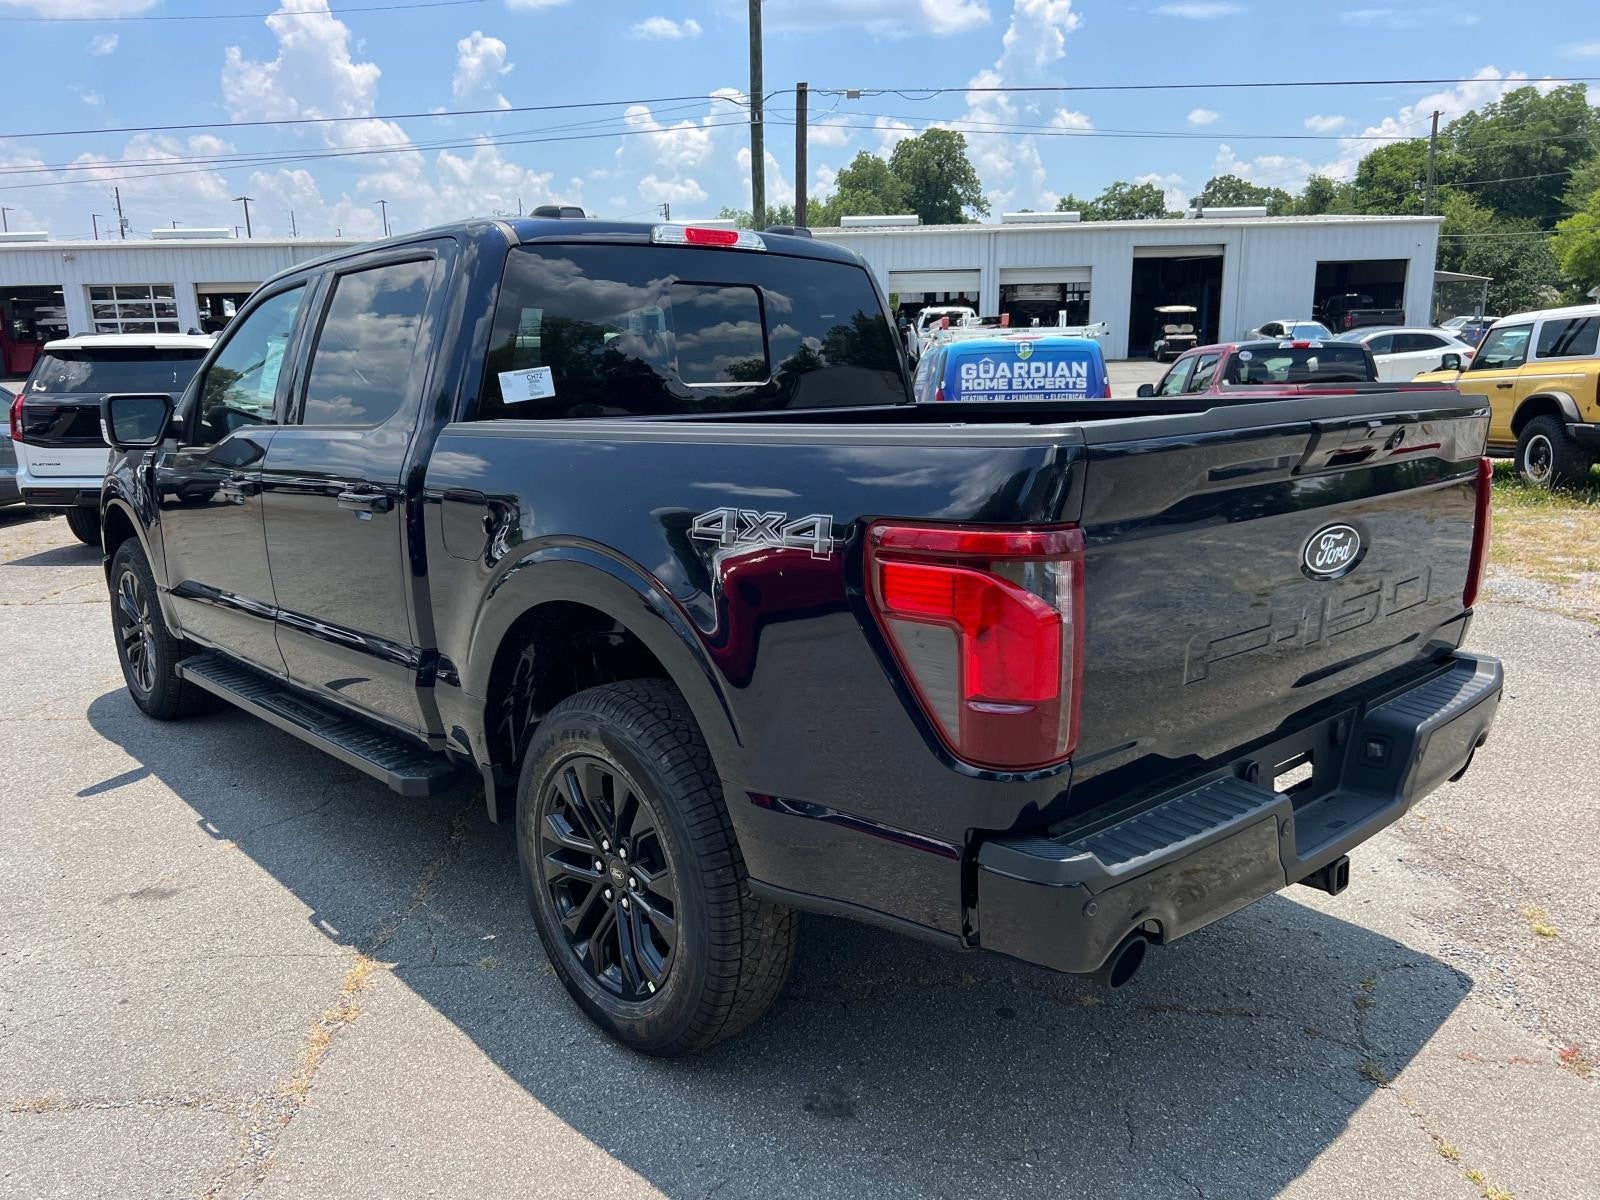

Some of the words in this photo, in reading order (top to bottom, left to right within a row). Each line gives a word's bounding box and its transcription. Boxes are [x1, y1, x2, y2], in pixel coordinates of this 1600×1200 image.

[960, 361, 1088, 378] GUARDIAN
[961, 379, 1009, 391] HOME
[1012, 377, 1087, 389] EXPERTS
[960, 394, 988, 402] HEATING
[1011, 393, 1044, 401] PLUMBING
[1050, 392, 1086, 400] ELECTRICAL
[1315, 532, 1353, 567] Ford
